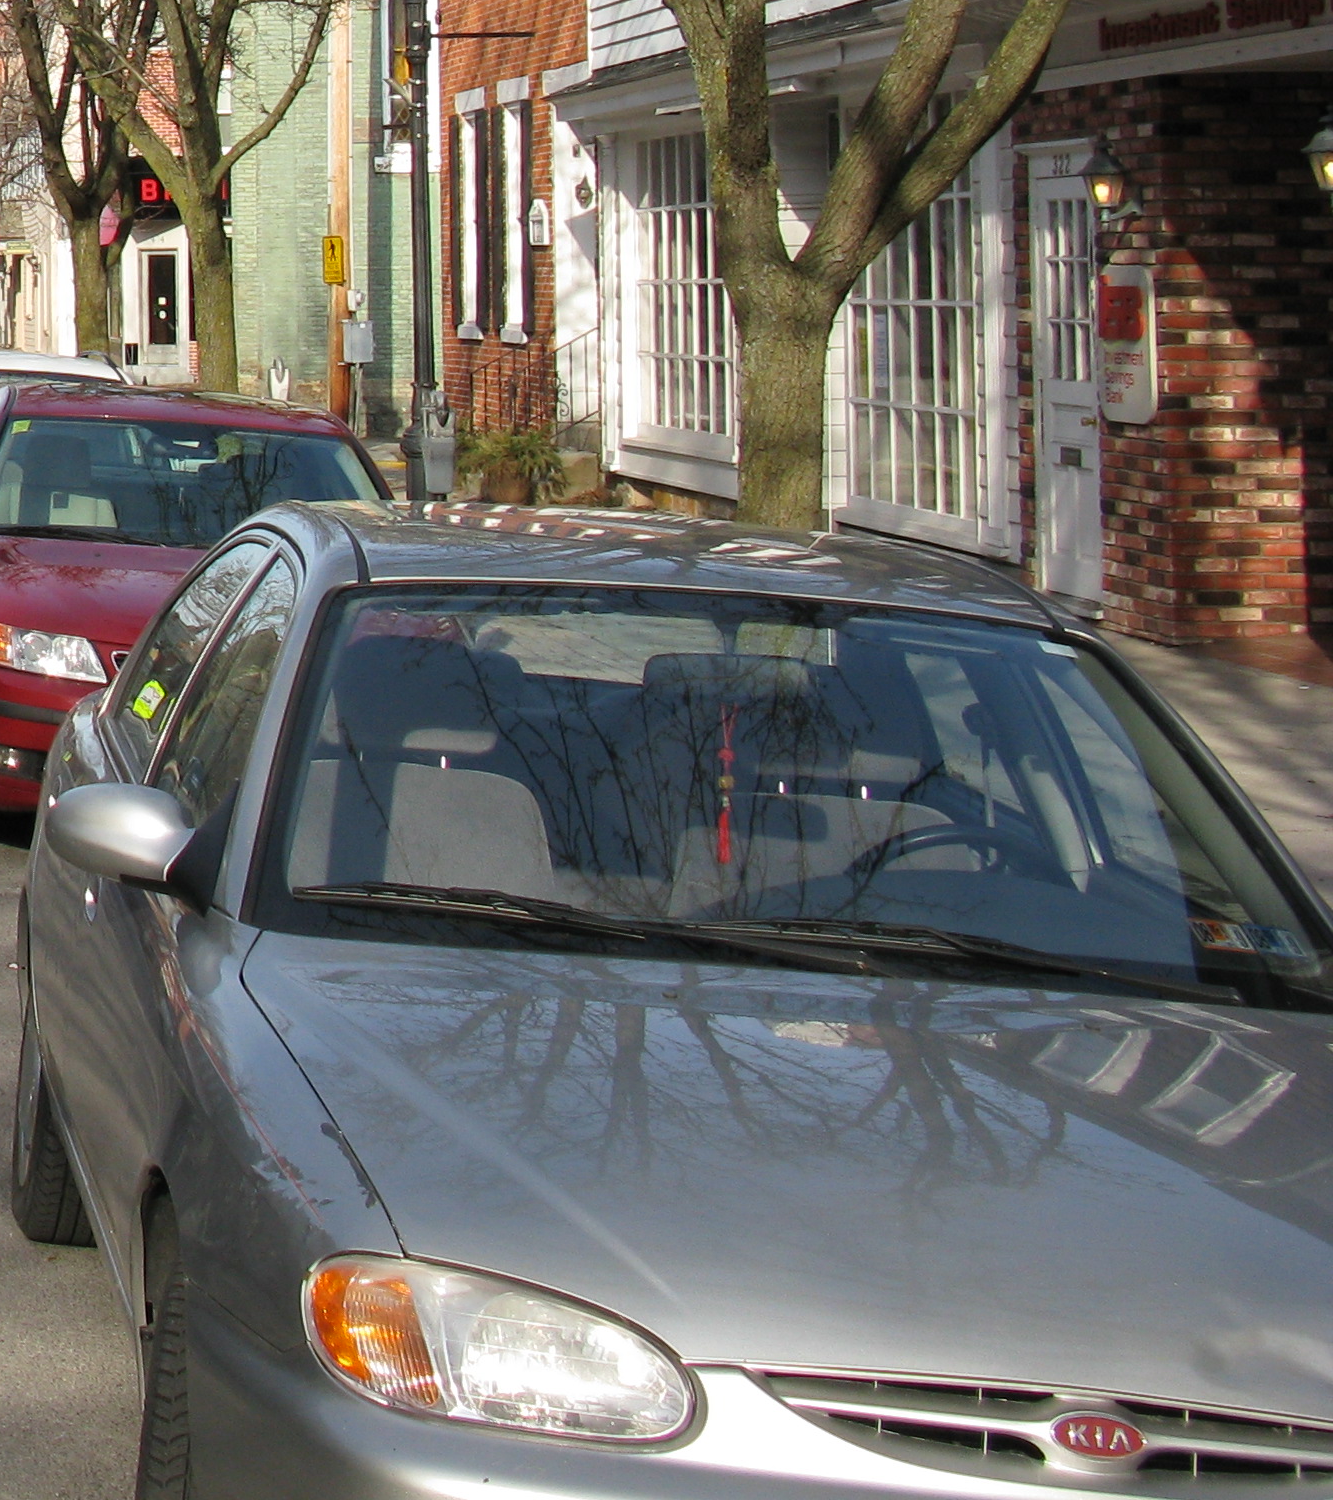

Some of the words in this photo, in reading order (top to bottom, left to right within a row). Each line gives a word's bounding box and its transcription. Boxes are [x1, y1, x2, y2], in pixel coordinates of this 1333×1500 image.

[1098, 0, 1220, 51] Investment
[1053, 153, 1070, 175] 322
[1104, 367, 1135, 389] Savings
[1105, 386, 1124, 404] Bank
[1068, 1422, 1132, 1453] KIA
